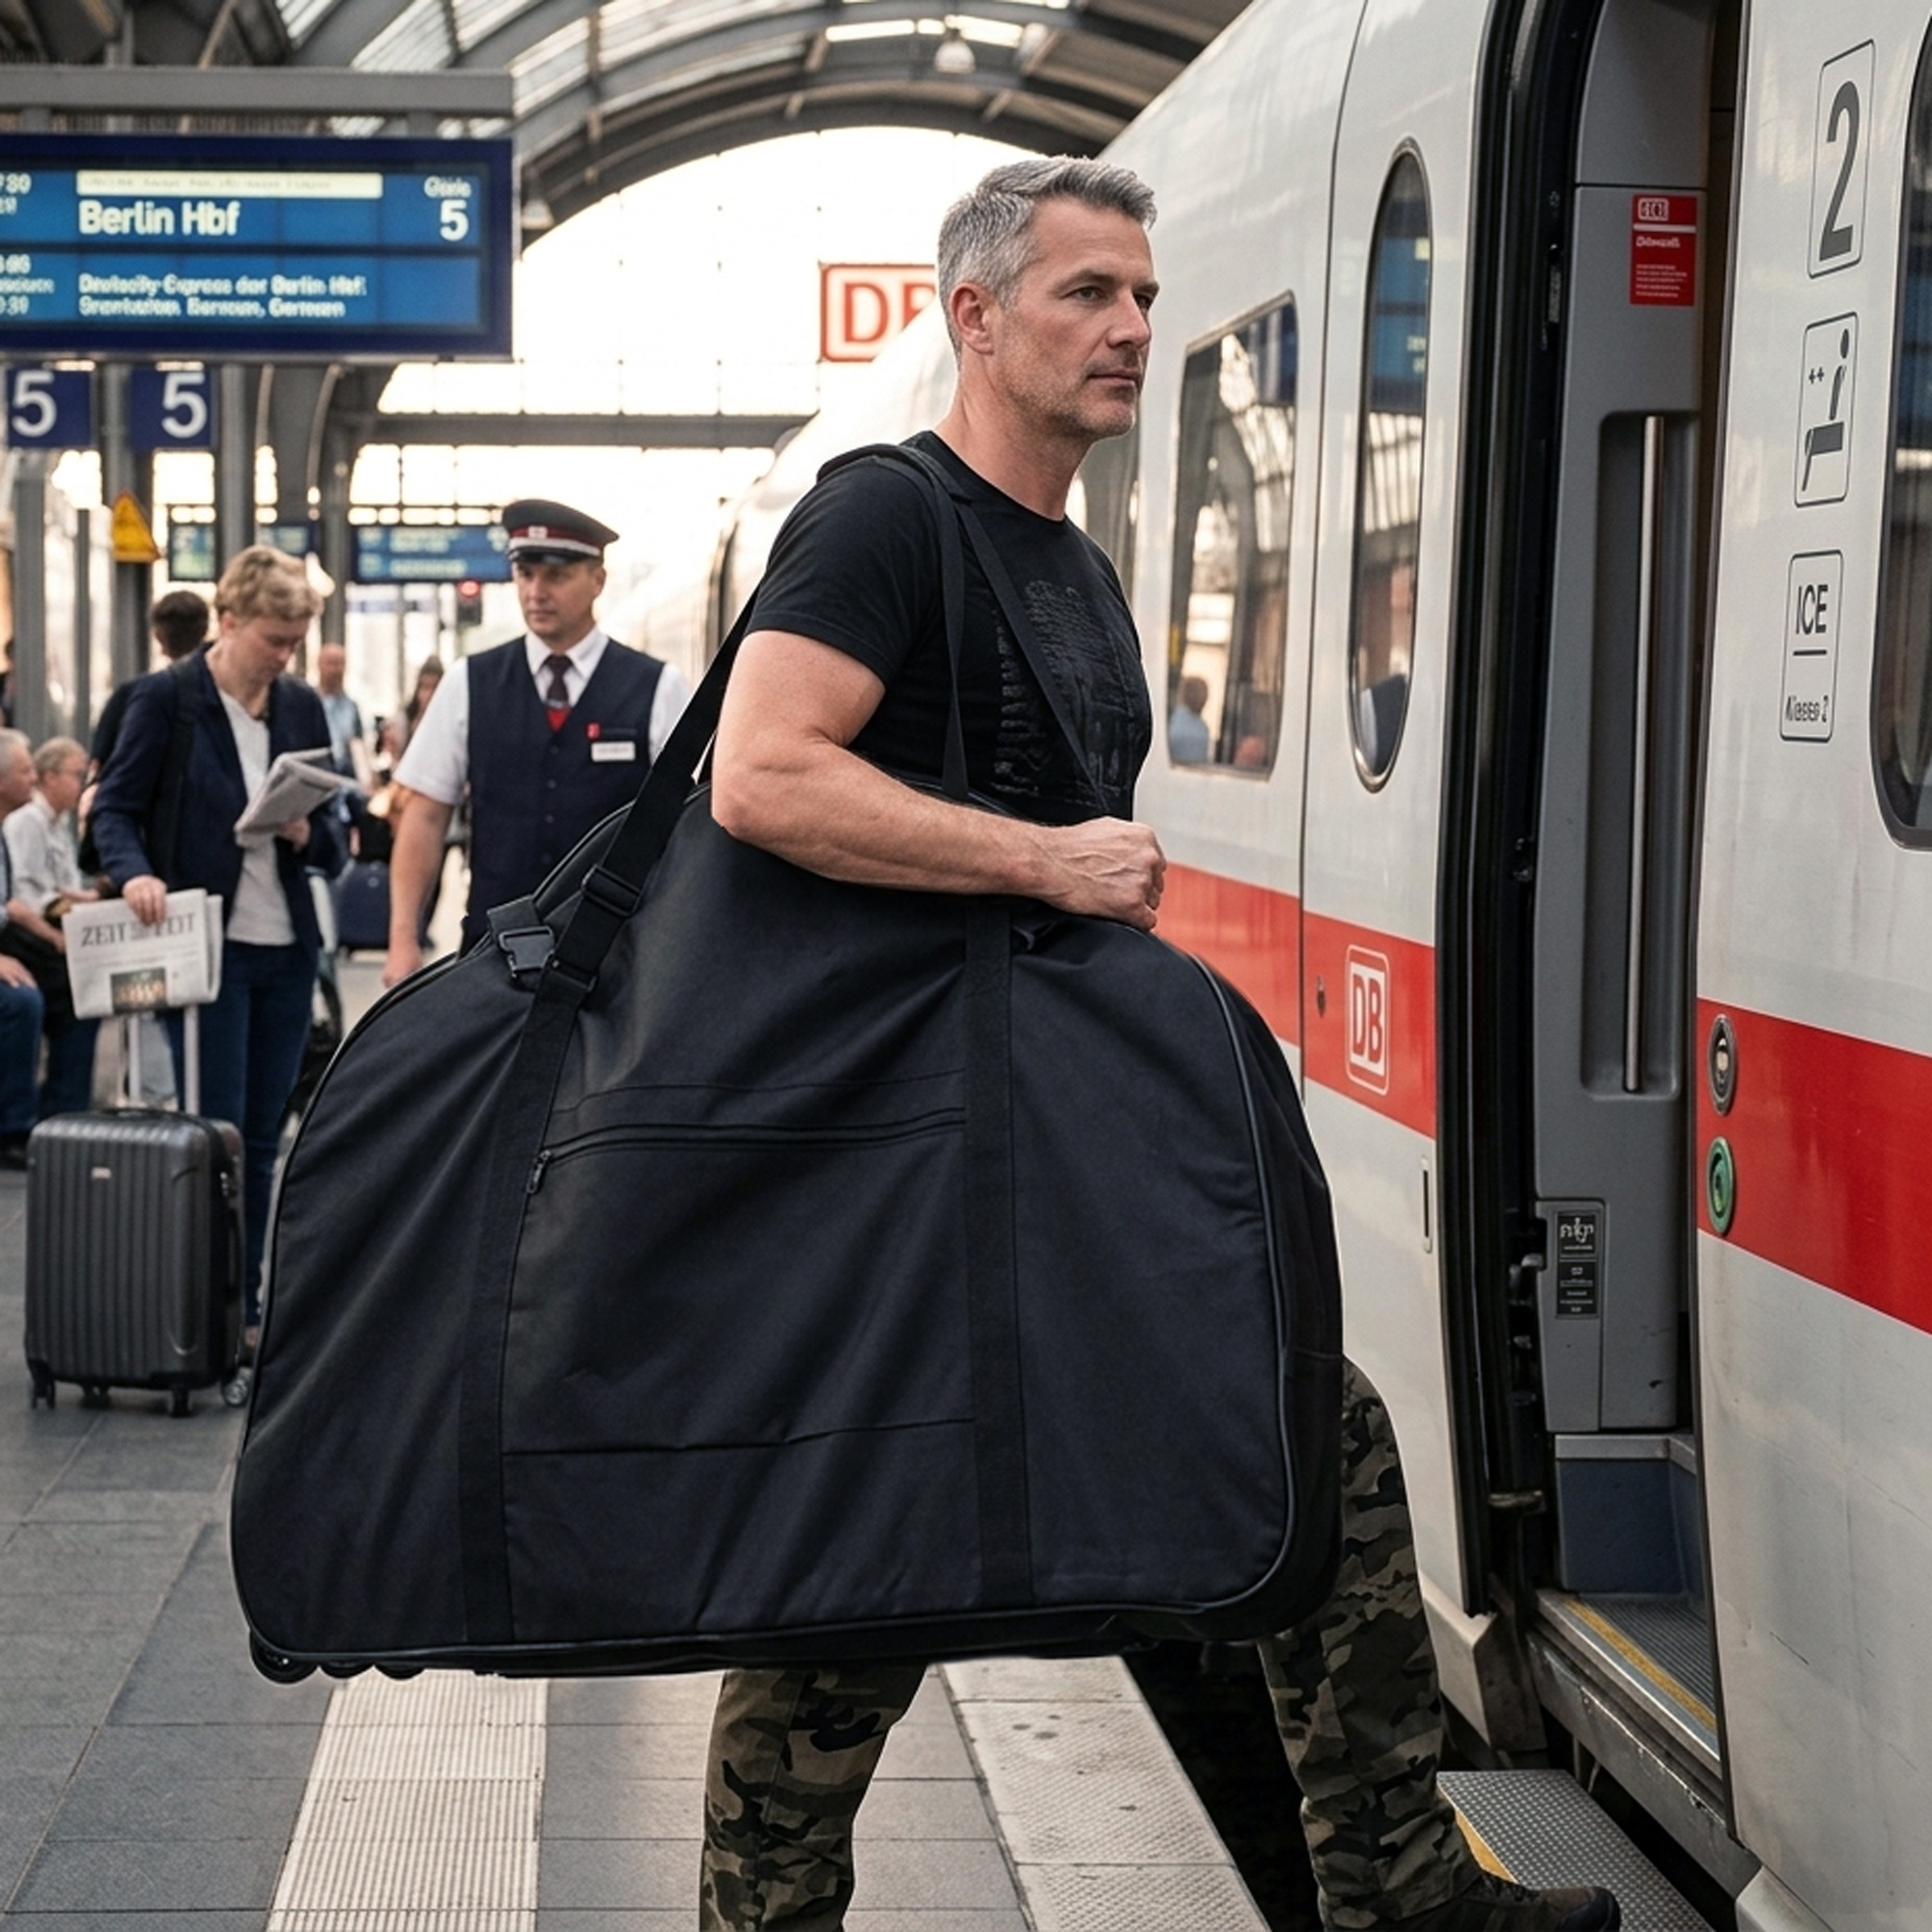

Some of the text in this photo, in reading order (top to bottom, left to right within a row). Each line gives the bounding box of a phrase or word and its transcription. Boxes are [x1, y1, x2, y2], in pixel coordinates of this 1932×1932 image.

[1819, 81, 1860, 262] 2
[79, 199, 241, 236] Berlin Hbf
[440, 199, 469, 241] 5
[12, 370, 57, 438] 5
[161, 372, 208, 438] 5
[1796, 584, 1829, 635] ICE
[1353, 974, 1382, 1065] DB
